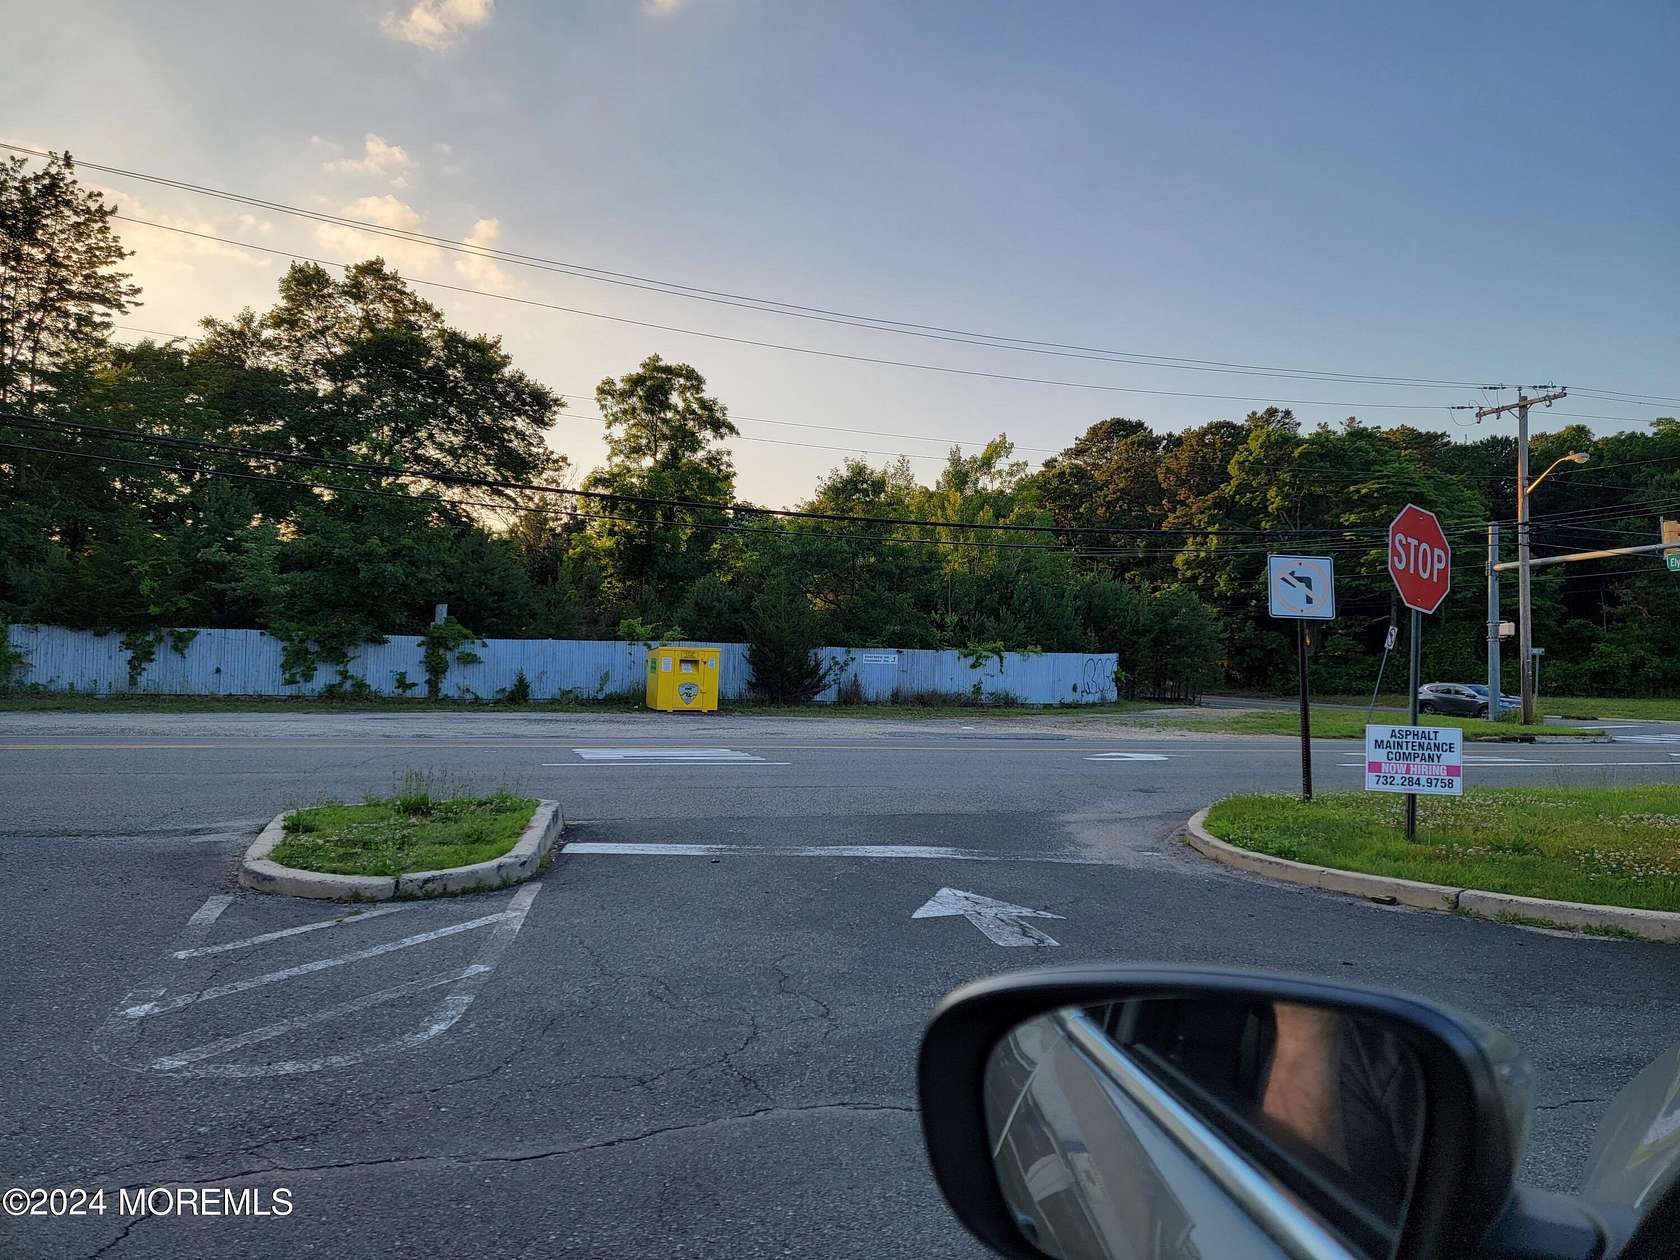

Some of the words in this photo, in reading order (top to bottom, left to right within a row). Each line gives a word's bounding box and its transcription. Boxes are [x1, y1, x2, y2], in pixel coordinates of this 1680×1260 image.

[1393, 533, 1446, 583] STOP
[1390, 729, 1439, 741] ASPHALT
[1374, 739, 1455, 753] MAINTENANCE
[1386, 750, 1442, 763] COMPANY
[1381, 762, 1407, 774] NOW
[1409, 764, 1448, 777] HIRING
[1375, 775, 1454, 789] 732.284.9758
